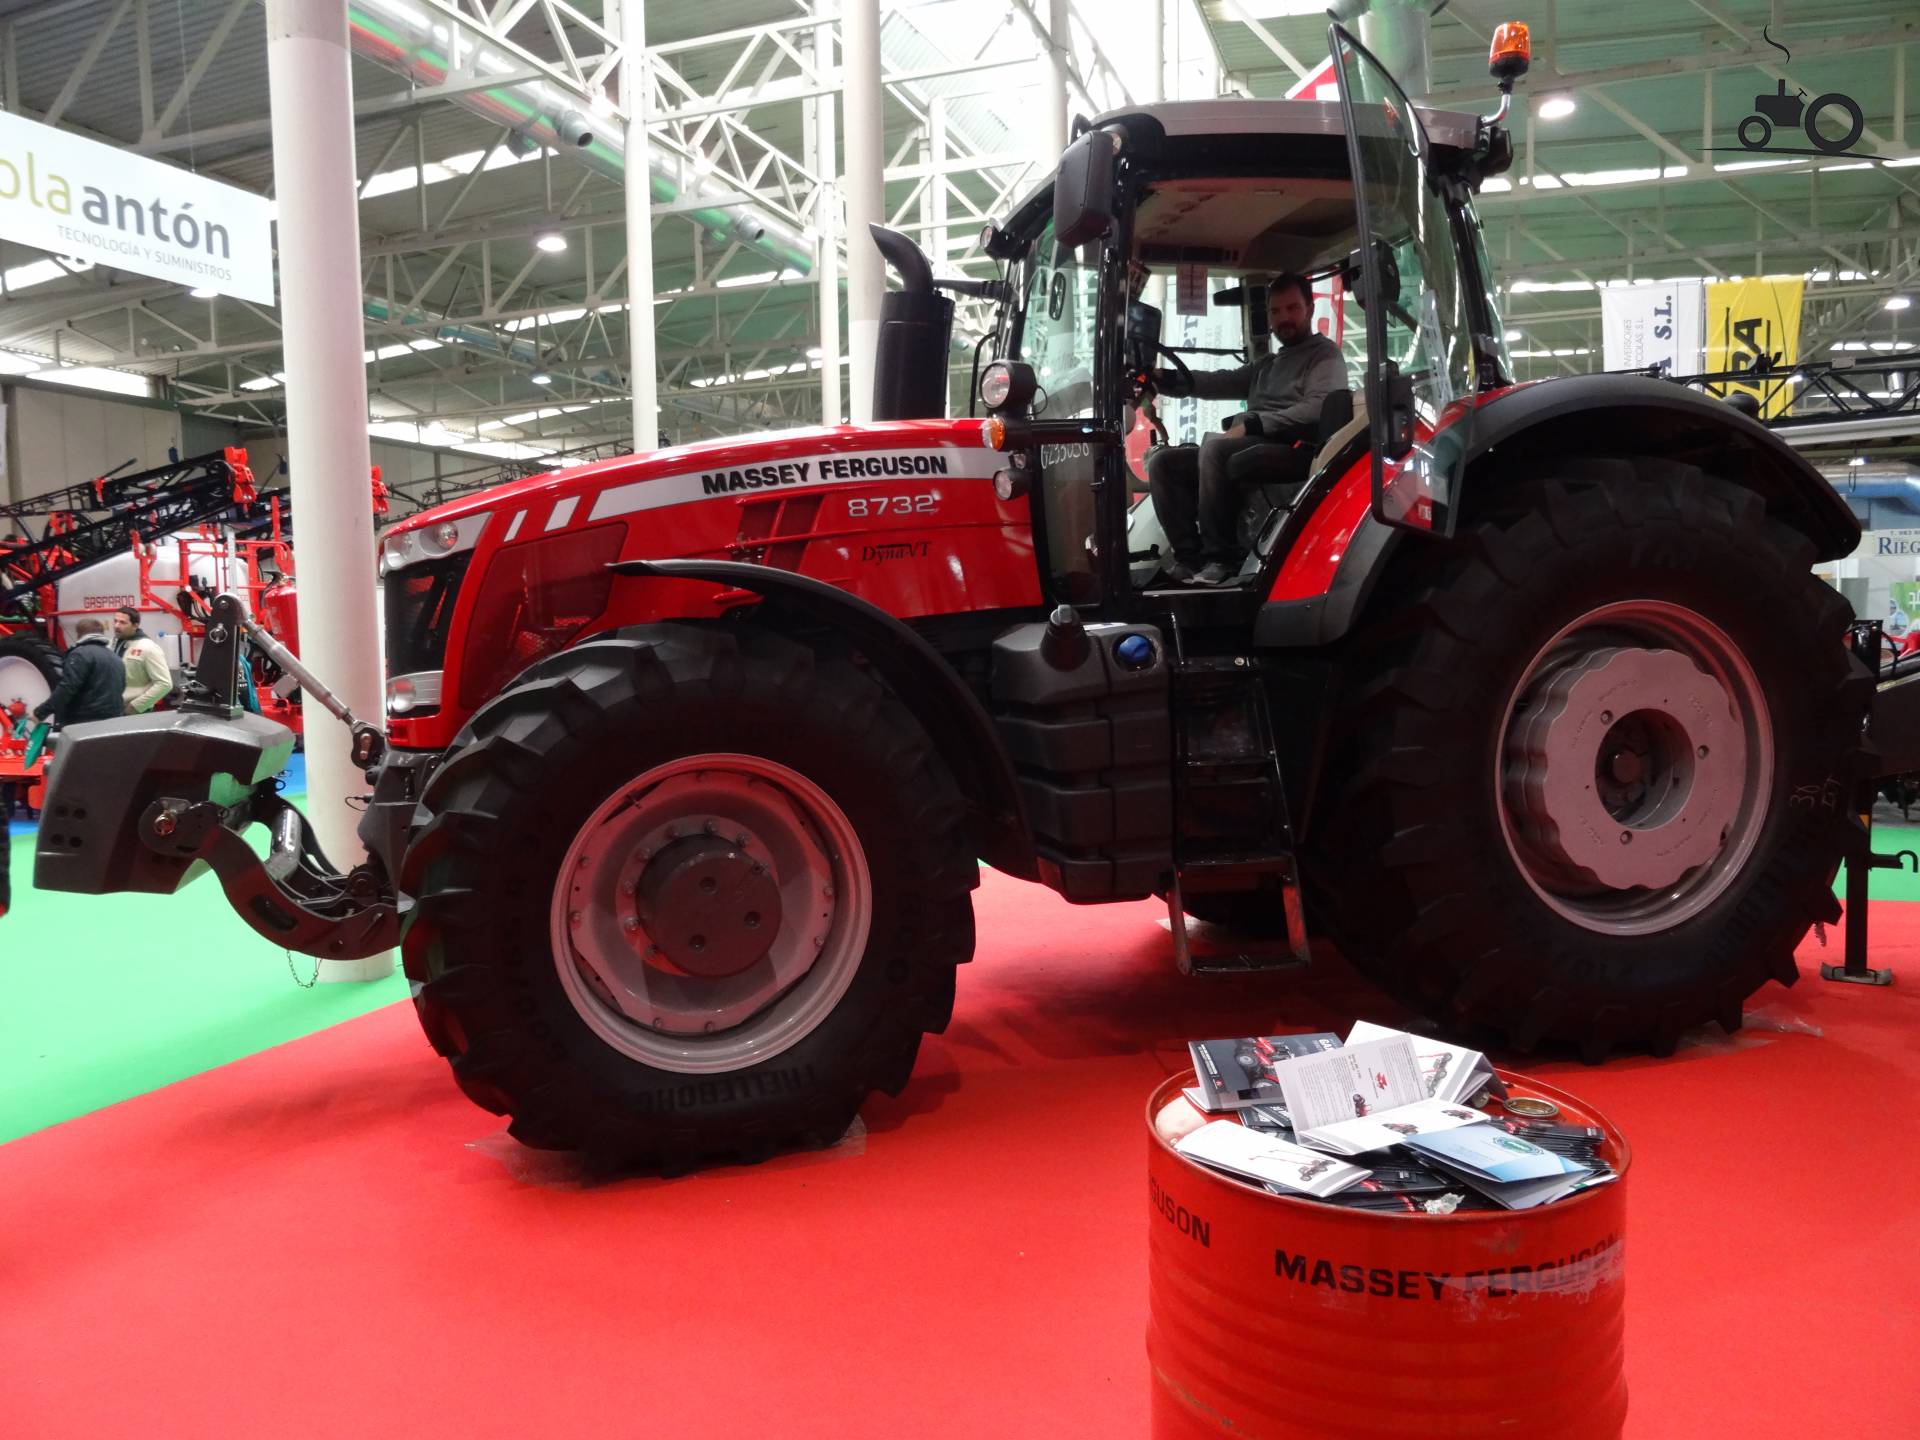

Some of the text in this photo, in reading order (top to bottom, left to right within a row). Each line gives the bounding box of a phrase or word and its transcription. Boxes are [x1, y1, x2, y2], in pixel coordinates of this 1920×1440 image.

[57, 225, 232, 281] TECNOLOGÍA Y SUMINISTROS
[1653, 295, 1673, 340] S.L.
[701, 455, 948, 495] MASSEY FERGUSON
[847, 494, 939, 518] 8732
[1275, 1248, 1450, 1301] MASSEY
